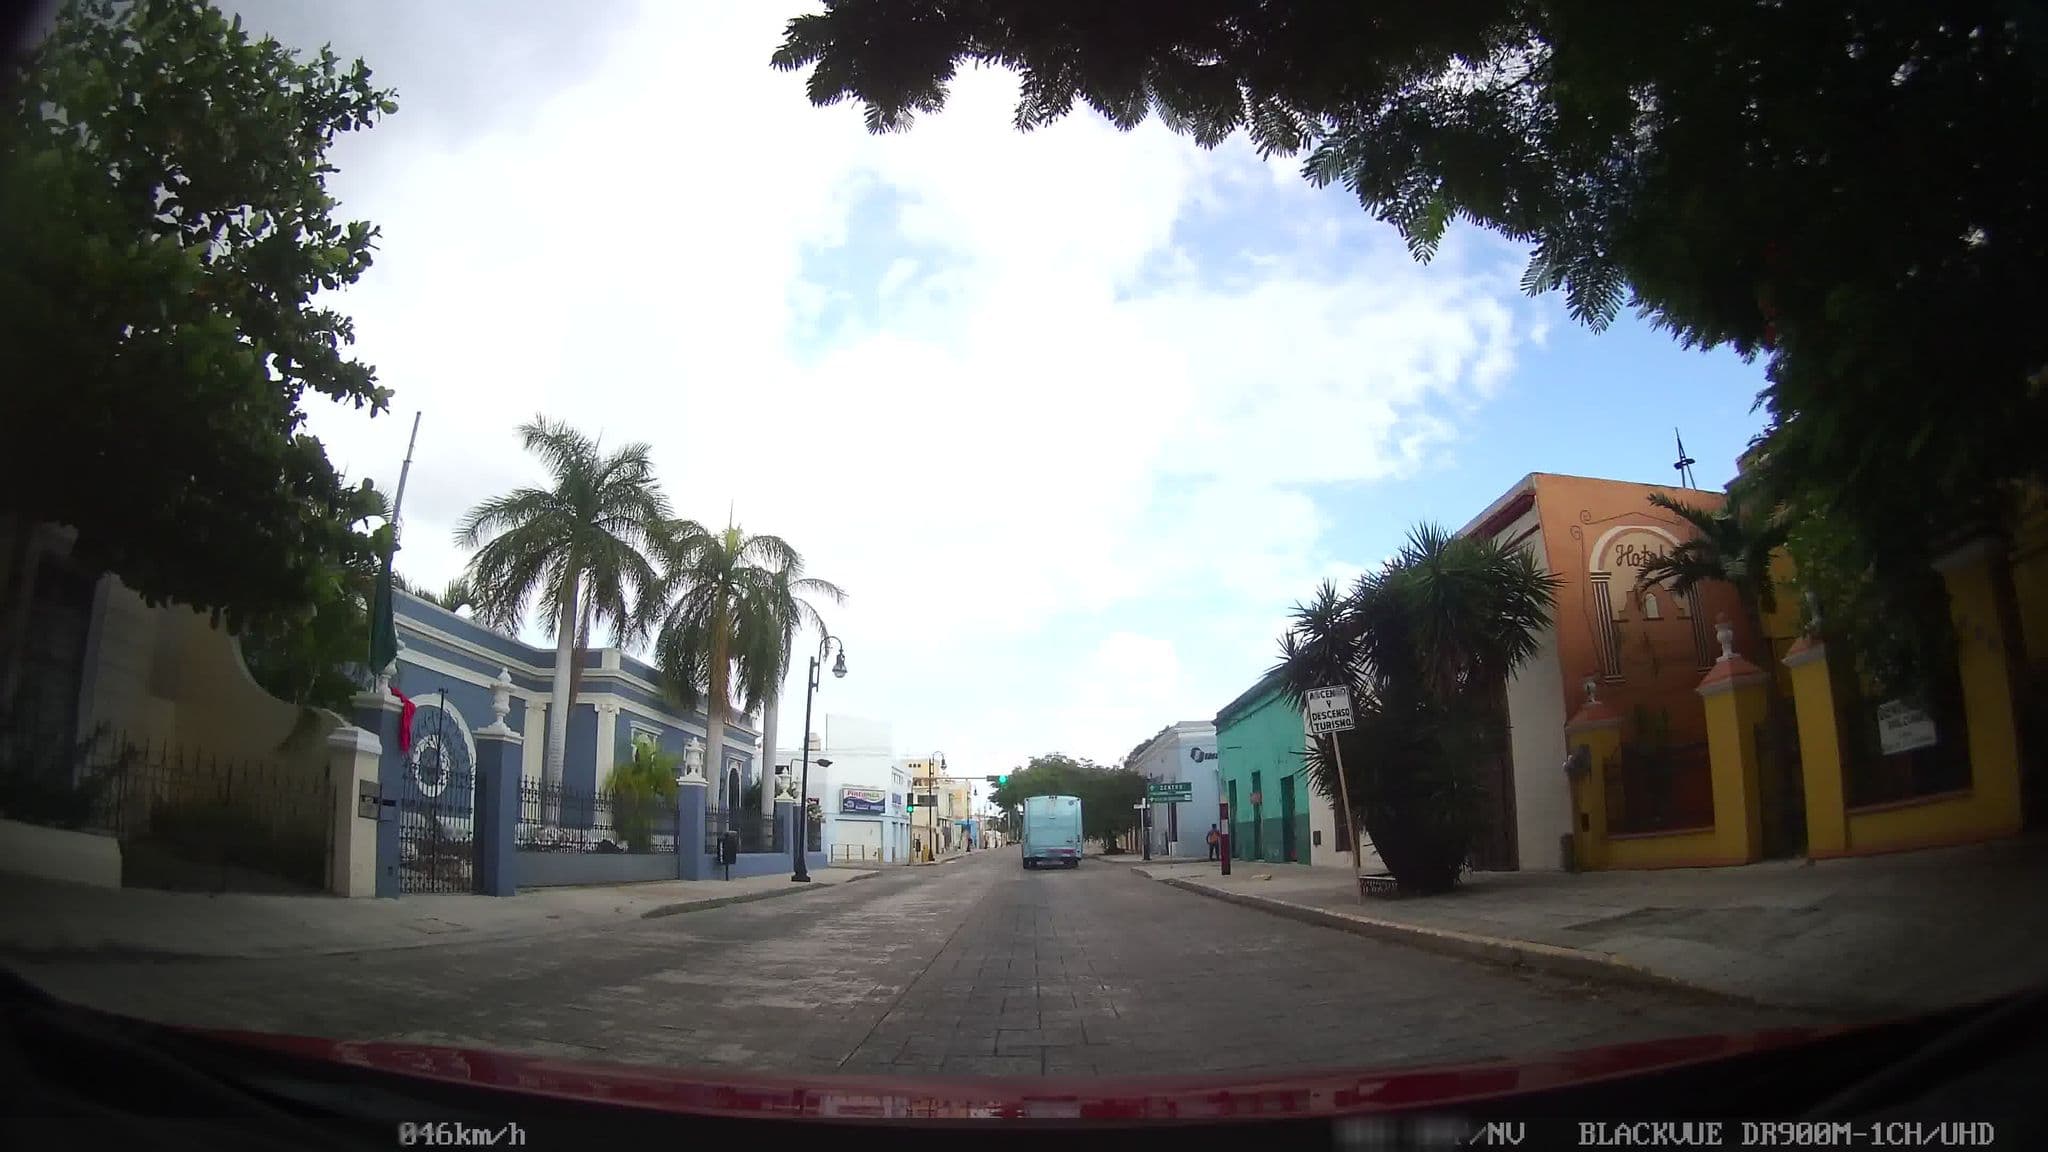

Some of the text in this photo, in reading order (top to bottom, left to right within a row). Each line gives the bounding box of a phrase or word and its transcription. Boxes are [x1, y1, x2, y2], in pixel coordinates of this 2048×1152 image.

[1615, 544, 1664, 566] Hotl
[1326, 700, 1331, 708] Y
[1312, 708, 1350, 721] DESCENSO
[1313, 719, 1351, 731] TURISMO
